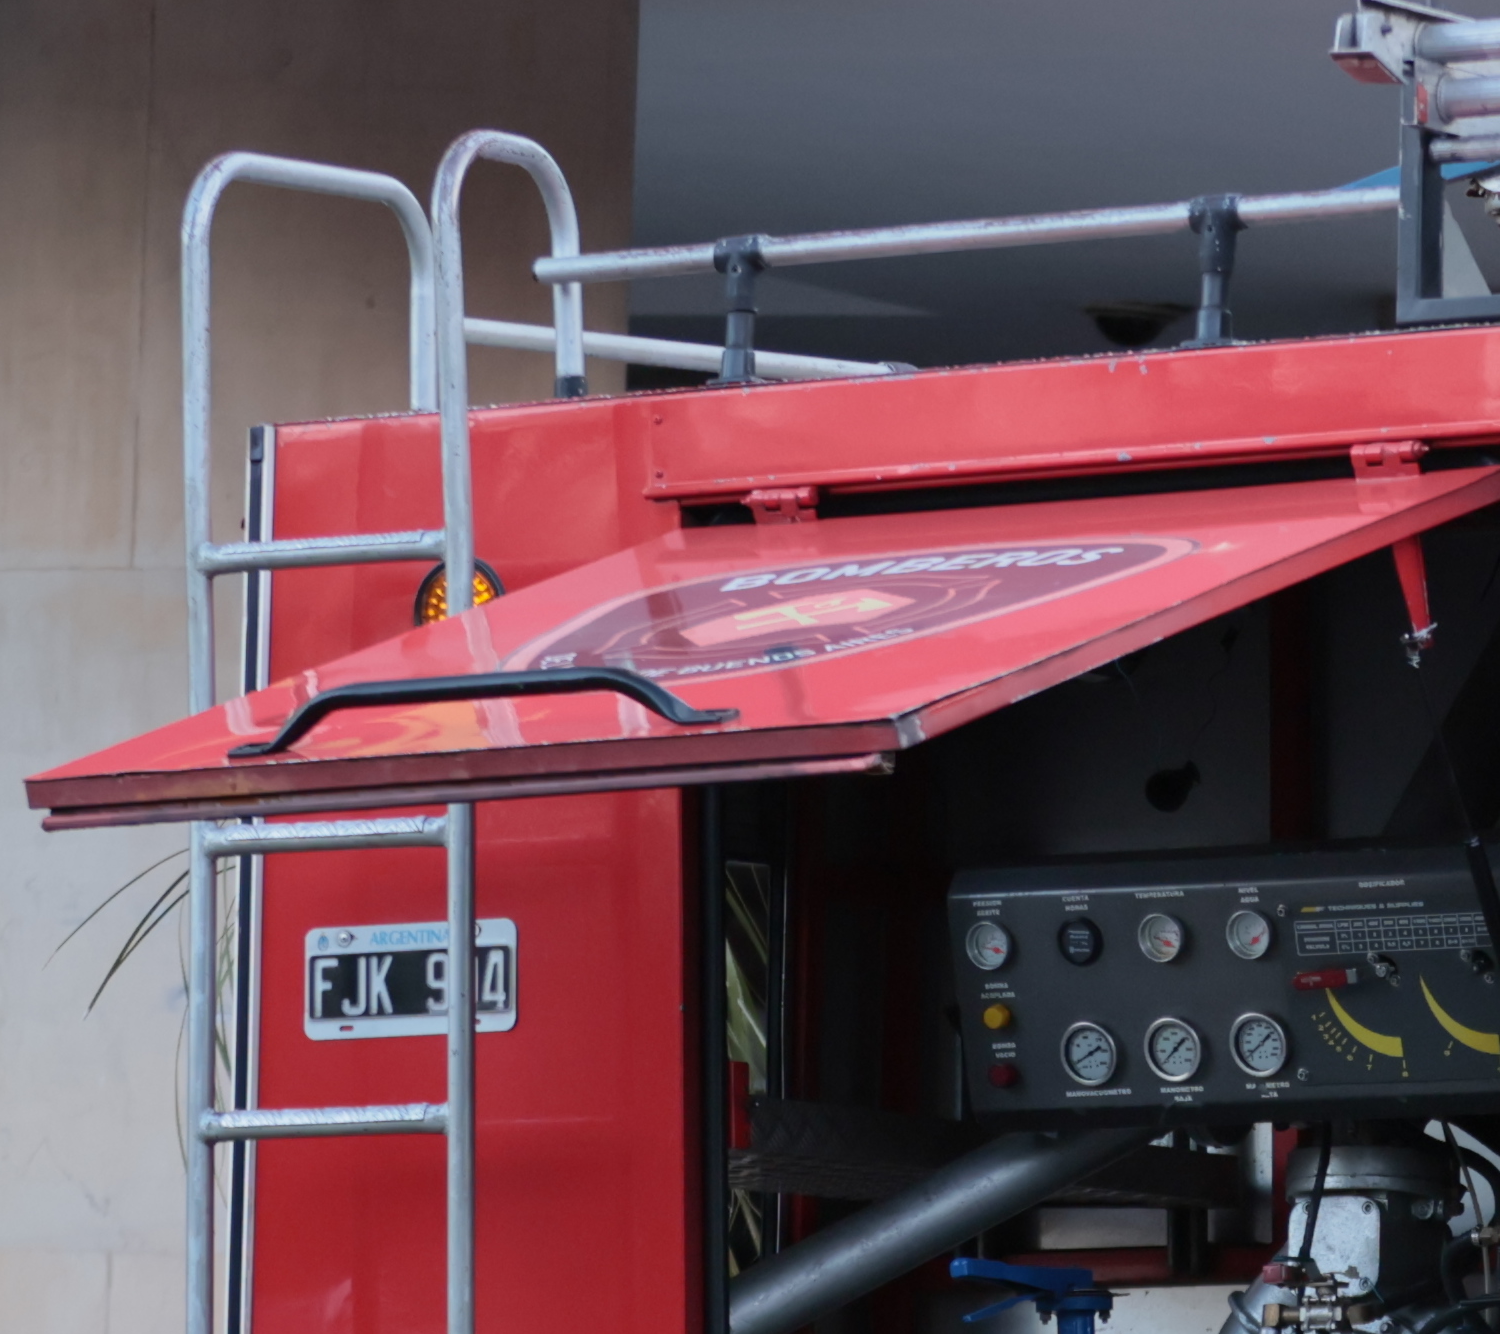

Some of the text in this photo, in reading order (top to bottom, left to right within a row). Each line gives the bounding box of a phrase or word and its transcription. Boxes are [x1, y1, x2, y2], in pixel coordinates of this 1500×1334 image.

[719, 545, 1125, 593] BOMBEROS
[677, 648, 817, 676] BUENOS
[823, 626, 915, 653] AIRES
[313, 949, 506, 1018] FJK 94
